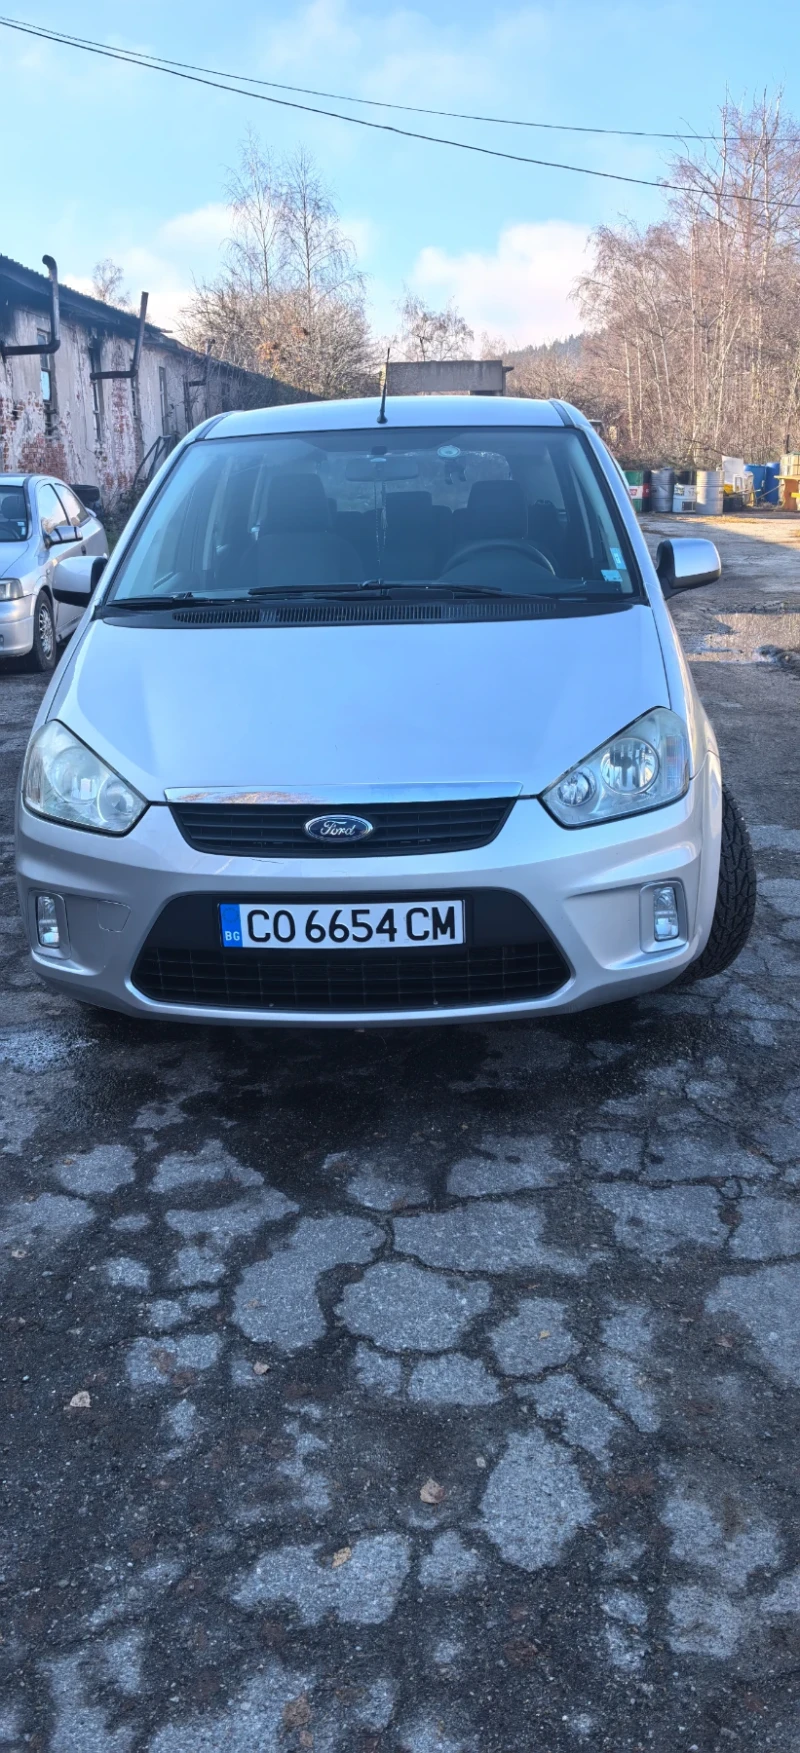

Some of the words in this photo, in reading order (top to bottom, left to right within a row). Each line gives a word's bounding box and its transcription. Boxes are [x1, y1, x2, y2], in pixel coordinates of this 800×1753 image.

[320, 820, 356, 836] Ford
[247, 909, 296, 943] CO
[305, 909, 397, 943] 6654
[406, 906, 455, 941] CM
[225, 931, 240, 941] BG
